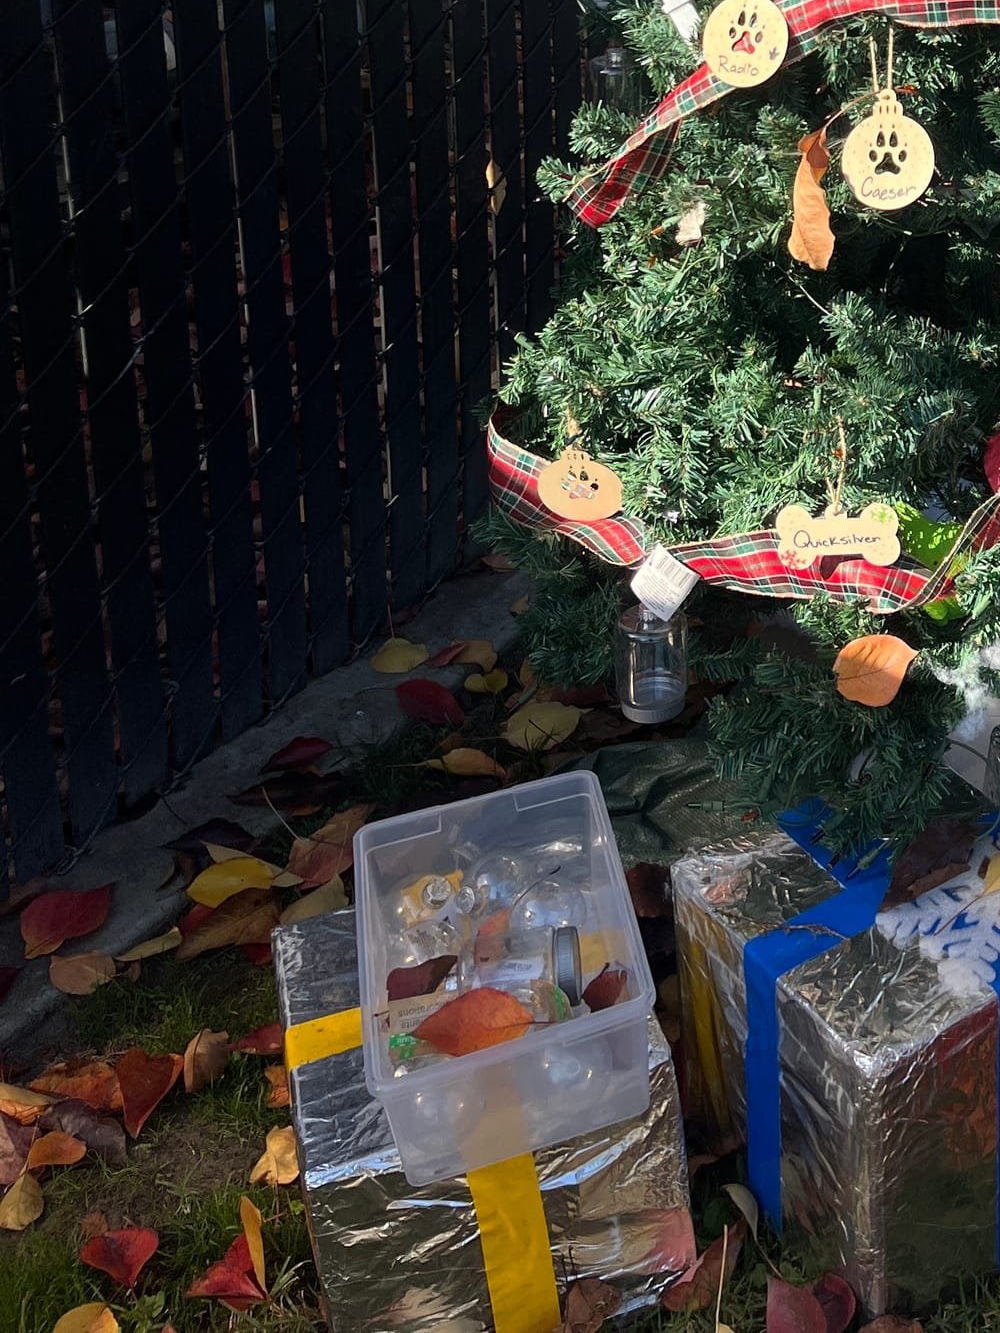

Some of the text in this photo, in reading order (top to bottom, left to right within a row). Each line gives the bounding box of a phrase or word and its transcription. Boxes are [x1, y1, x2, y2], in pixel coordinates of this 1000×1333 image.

[718, 55, 759, 76] Radio
[861, 176, 917, 200] Caeser
[793, 529, 881, 548] Quicksilver
